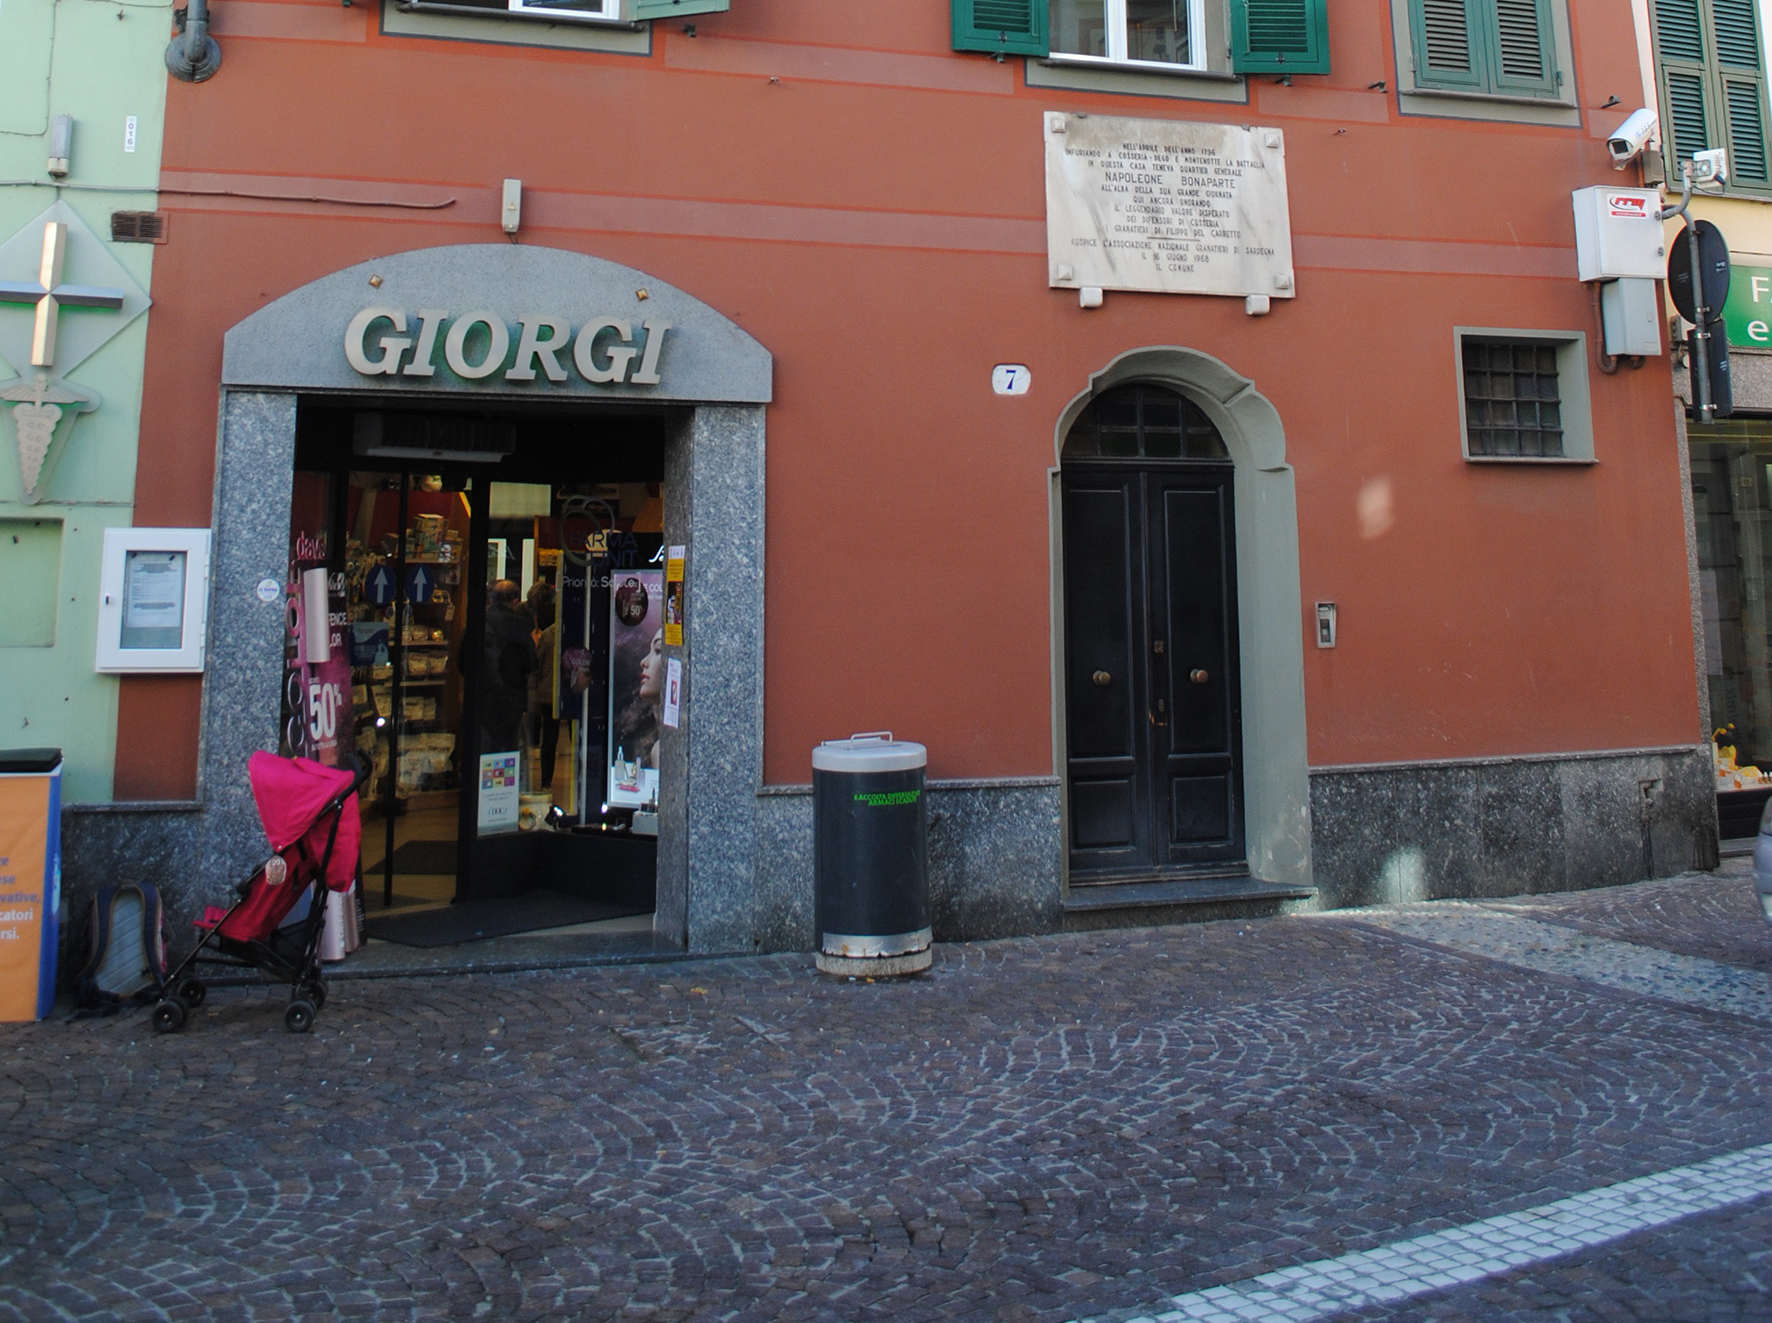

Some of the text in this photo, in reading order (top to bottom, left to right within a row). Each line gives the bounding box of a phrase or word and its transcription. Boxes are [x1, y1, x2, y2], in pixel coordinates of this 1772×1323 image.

[1065, 148, 1101, 158] INFURIANDO
[1175, 155, 1179, 163] E
[1184, 156, 1221, 166] MONTENOTTE
[1236, 160, 1266, 169] BATTAGLIA
[1163, 146, 1196, 155] DELL'ANNO
[1201, 148, 1216, 156] 1796
[1100, 160, 1124, 169] QUESTA
[1129, 162, 1146, 170] CASA
[1152, 163, 1174, 172] TENEVA
[1180, 165, 1208, 174] QUARTIER
[1213, 167, 1242, 177] GENERALE
[1105, 171, 1236, 189] NAPOLEONE BONAPARTE
[1101, 184, 1232, 199] ALL'ALBA DELLA SUA GRANDE GIORNATA
[1133, 195, 1211, 208] QUI ANCORA ONORANDO
[1114, 204, 1230, 218] IL LEGGENDARIO VALORE DISPERATO
[1126, 215, 1136, 223] DEI
[1142, 216, 1173, 225] DIFENSORI
[1178, 218, 1185, 226] DI
[1114, 224, 1148, 234] GRANATIERI
[1166, 227, 1188, 236] FILIPPO
[1193, 229, 1205, 237] DEL
[1210, 229, 1241, 239] CARRETTO
[1071, 238, 1097, 247] AUSPICE
[1157, 242, 1189, 251] NAZIONALE
[1195, 244, 1229, 253] GRANATIERI
[1233, 246, 1240, 254] DI
[1245, 247, 1275, 256] SARDEGNA
[1141, 252, 1147, 260] IL
[1166, 253, 1188, 262] GIUGNO
[1156, 263, 1195, 273] IL COMUNE
[344, 306, 672, 384] GIORGI
[1005, 369, 1017, 390] 7
